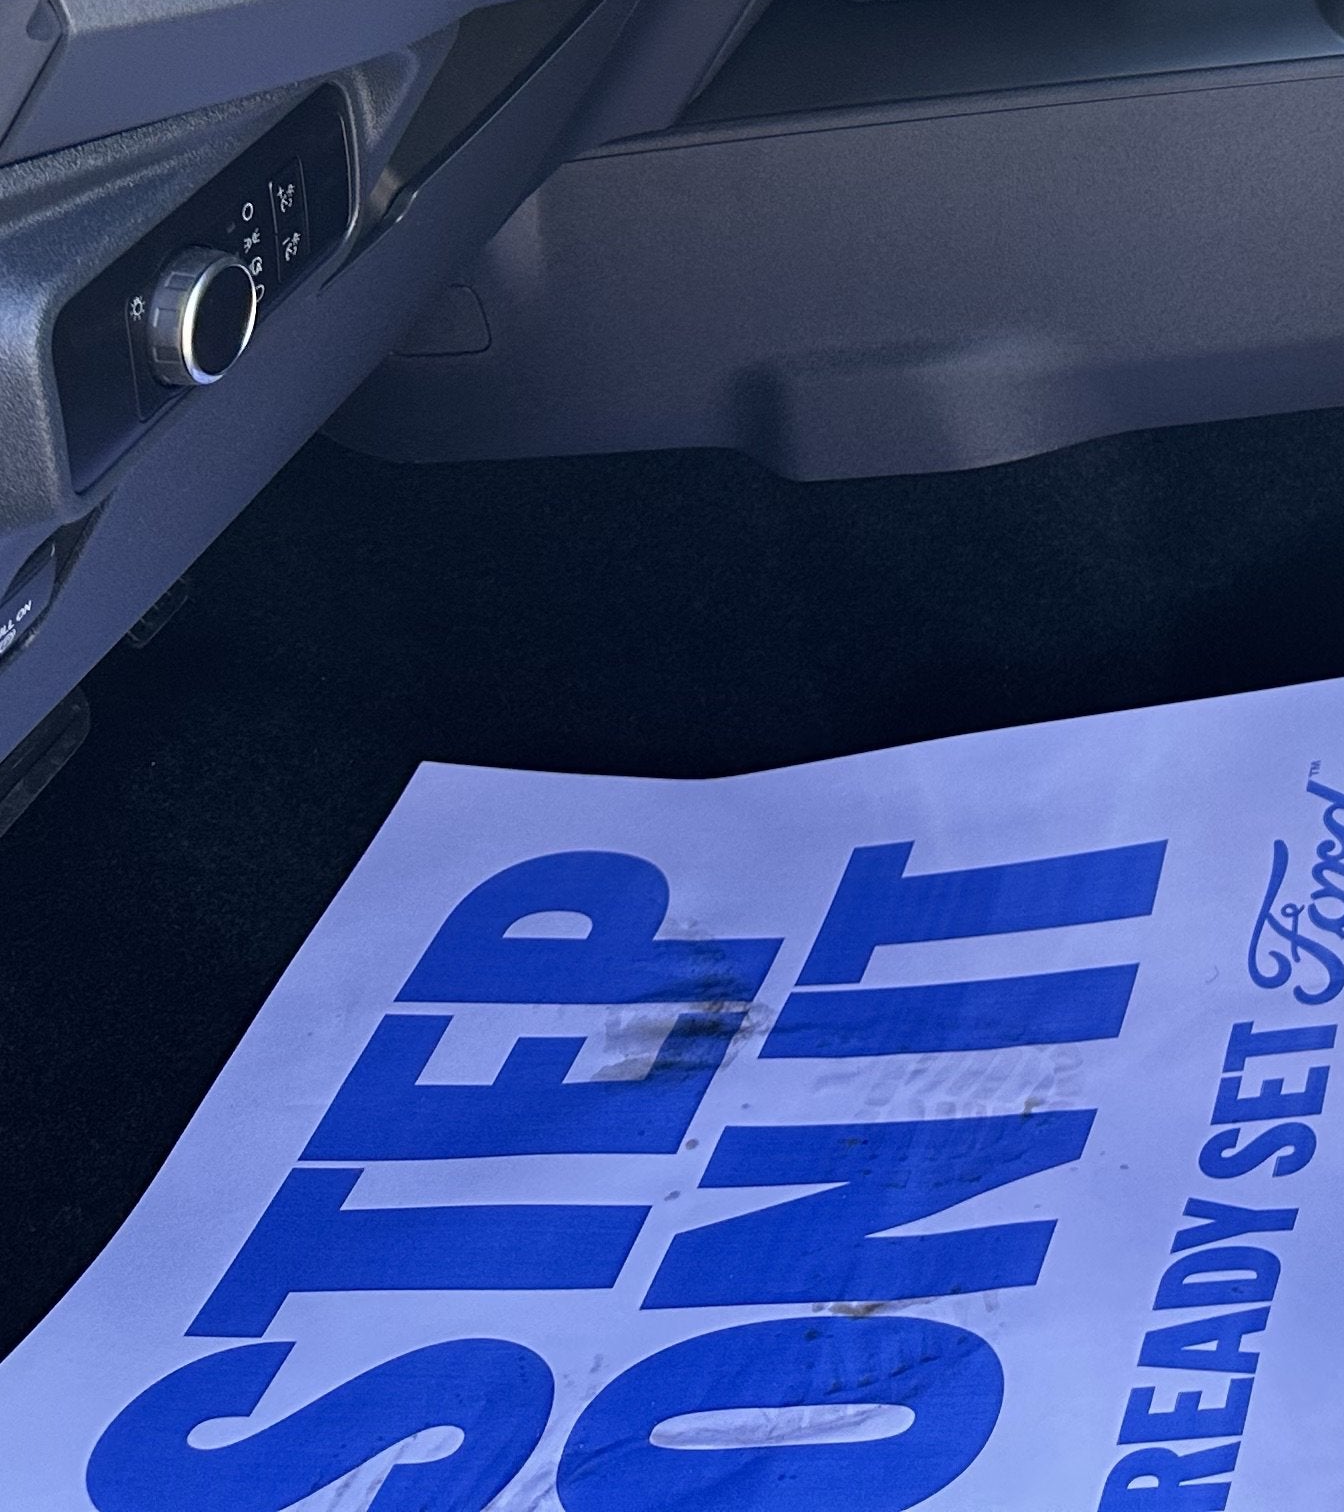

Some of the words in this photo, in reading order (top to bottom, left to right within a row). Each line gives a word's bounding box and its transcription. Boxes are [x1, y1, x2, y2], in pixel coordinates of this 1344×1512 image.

[16, 600, 32, 622] ON
[756, 839, 1168, 1059] IT
[86, 850, 785, 1512] STEP
[1198, 1021, 1338, 1180] SET
[556, 1108, 1099, 1512] ON
[1098, 1197, 1299, 1512] READY
